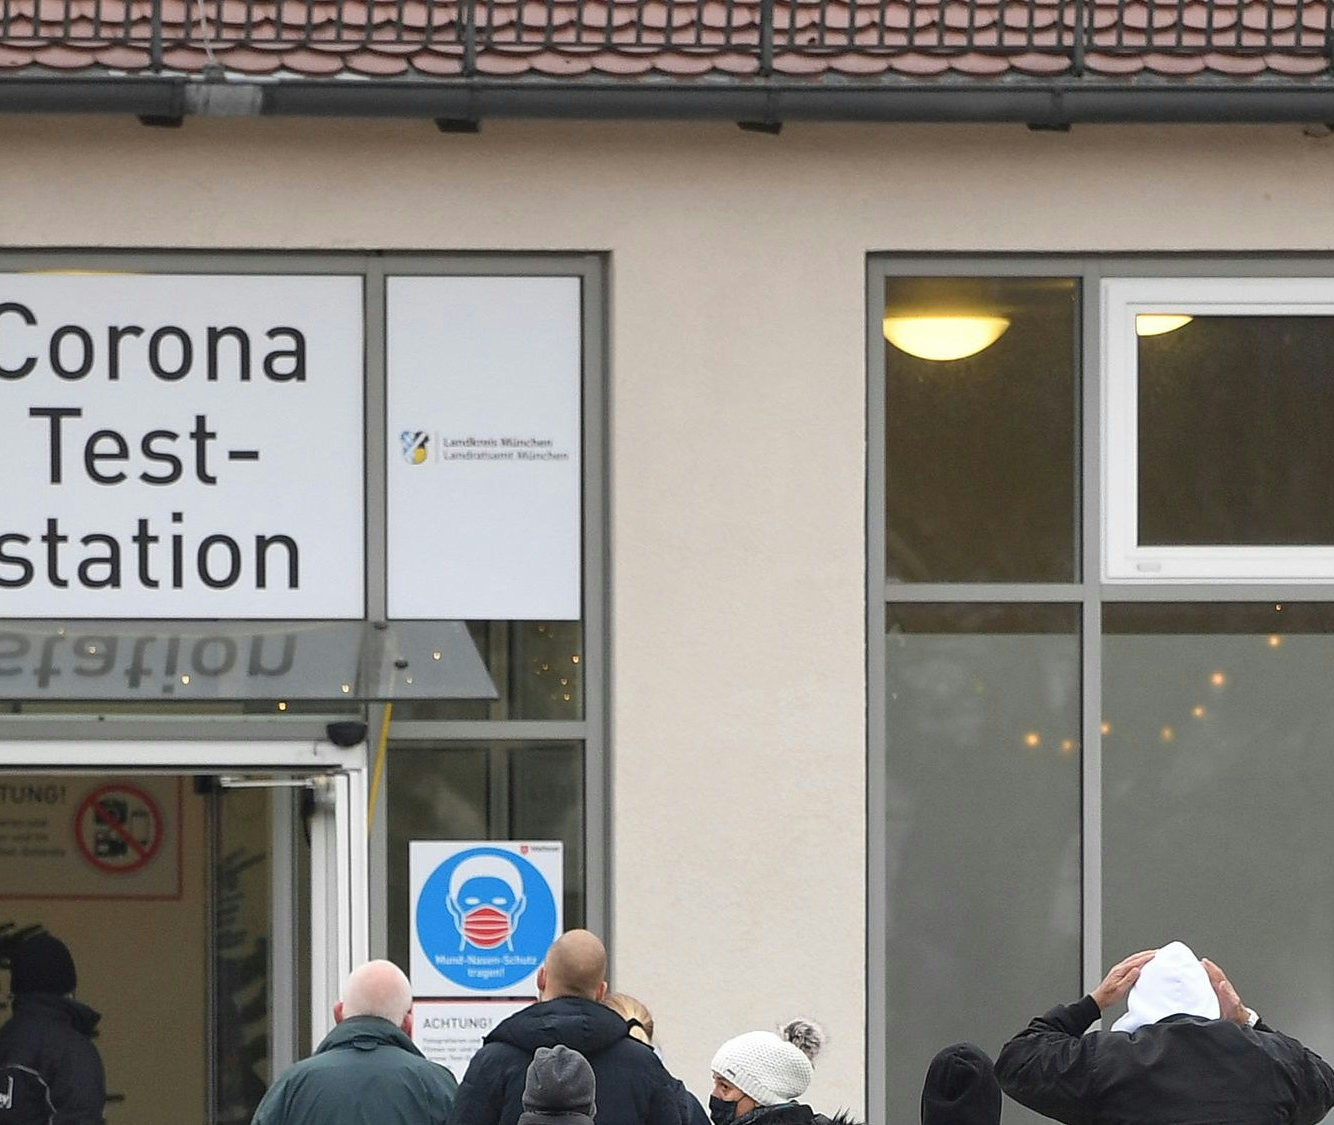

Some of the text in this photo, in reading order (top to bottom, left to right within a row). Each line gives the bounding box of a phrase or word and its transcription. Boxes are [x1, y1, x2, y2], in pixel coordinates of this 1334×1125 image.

[28, 406, 260, 487] Test-
[434, 955, 537, 966] Mund-Nasen-Schutz
[423, 1017, 492, 1030] ACHTUNG!
